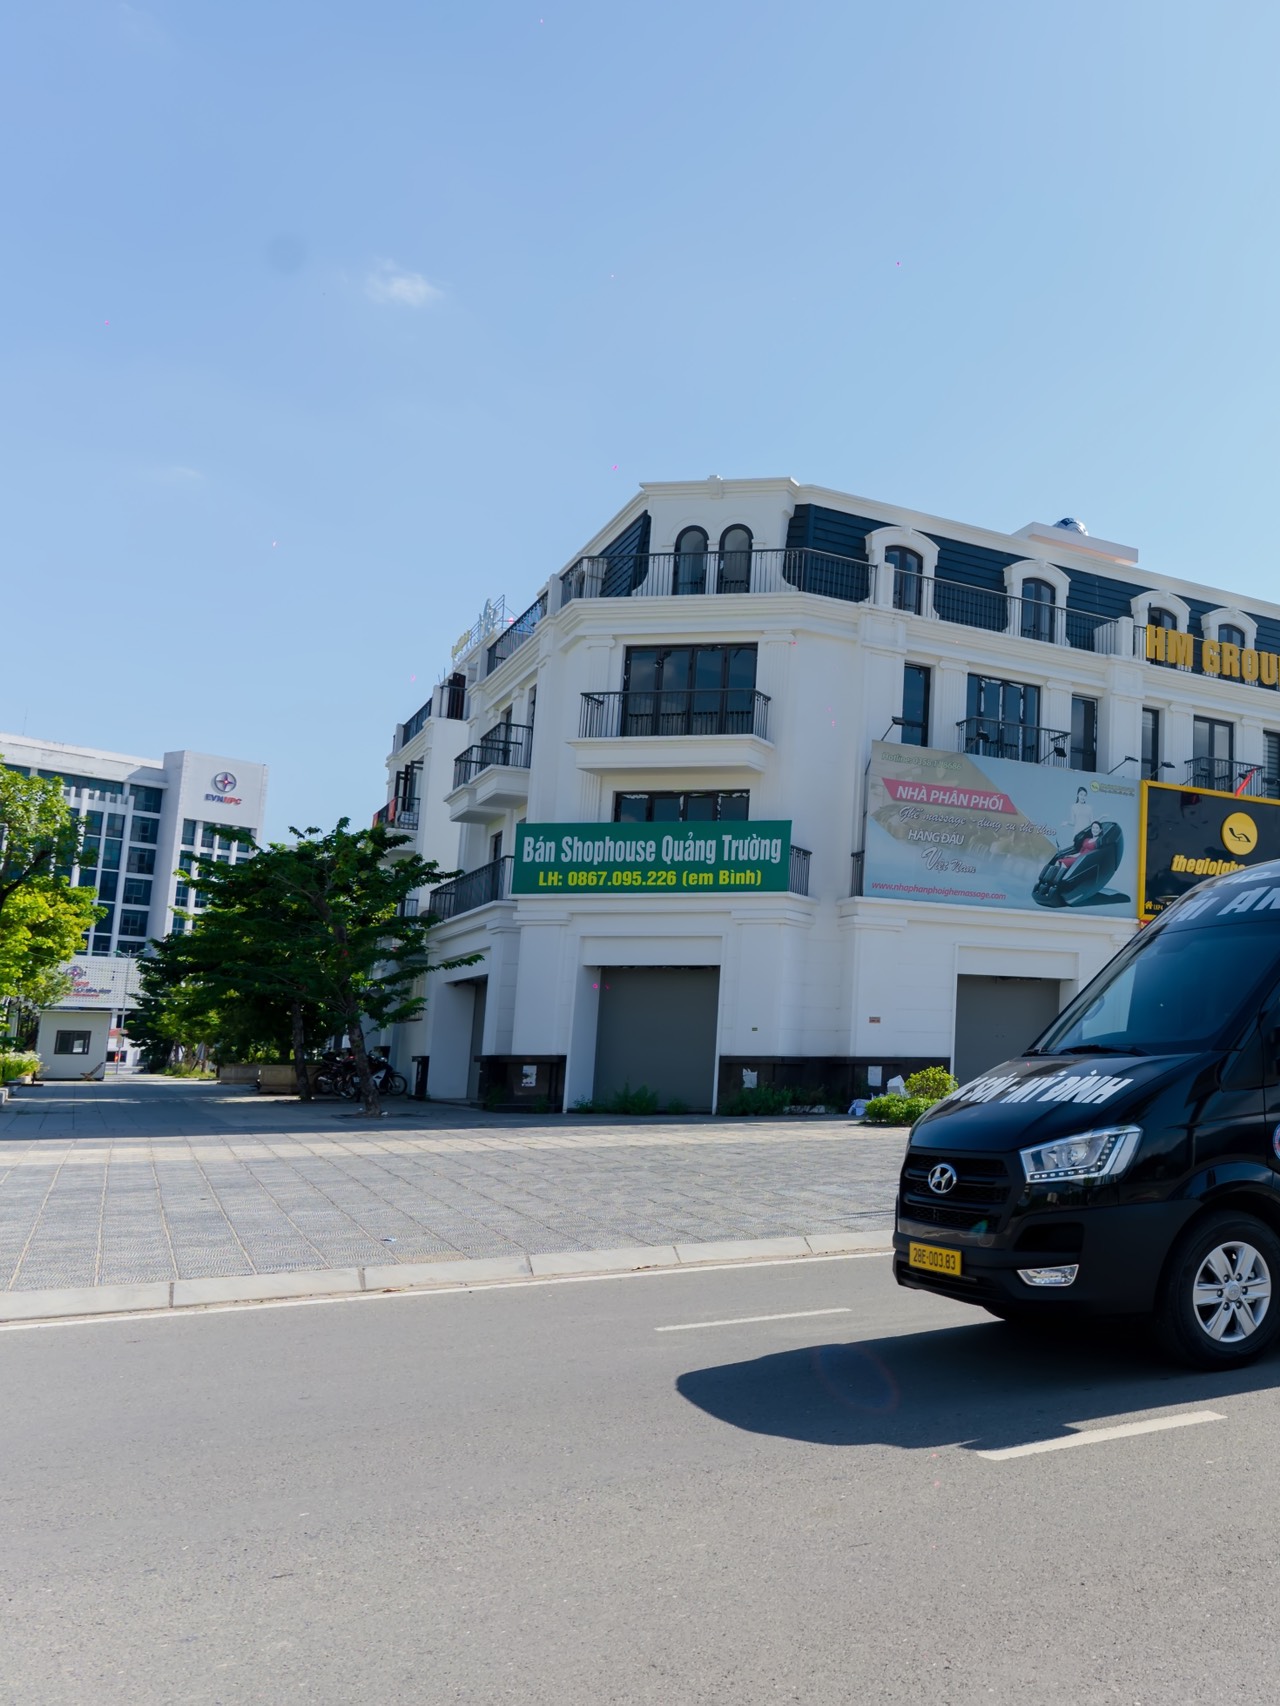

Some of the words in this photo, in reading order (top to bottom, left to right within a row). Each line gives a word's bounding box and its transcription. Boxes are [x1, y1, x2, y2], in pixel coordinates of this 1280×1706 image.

[1146, 624, 1194, 668] HM
[896, 785, 927, 801] NHÀ
[929, 789, 968, 806] PHÂN
[970, 795, 1003, 811] PHỐI
[923, 813, 966, 828] massage
[522, 835, 556, 863] Bán
[561, 835, 656, 865] Shophouse
[661, 832, 716, 865] Quảng
[722, 833, 782, 864] Trường
[908, 829, 940, 844] HÀNG
[539, 872, 562, 886] LH:
[567, 871, 677, 887] 0867.095.226
[682, 870, 714, 887] (em
[718, 869, 762, 886] Bình)
[871, 882, 1007, 901] www.nhaphanphoighemassage.com
[1036, 1070, 1134, 1103] ĐÌNH
[913, 1247, 956, 1271] 28E-003.83
